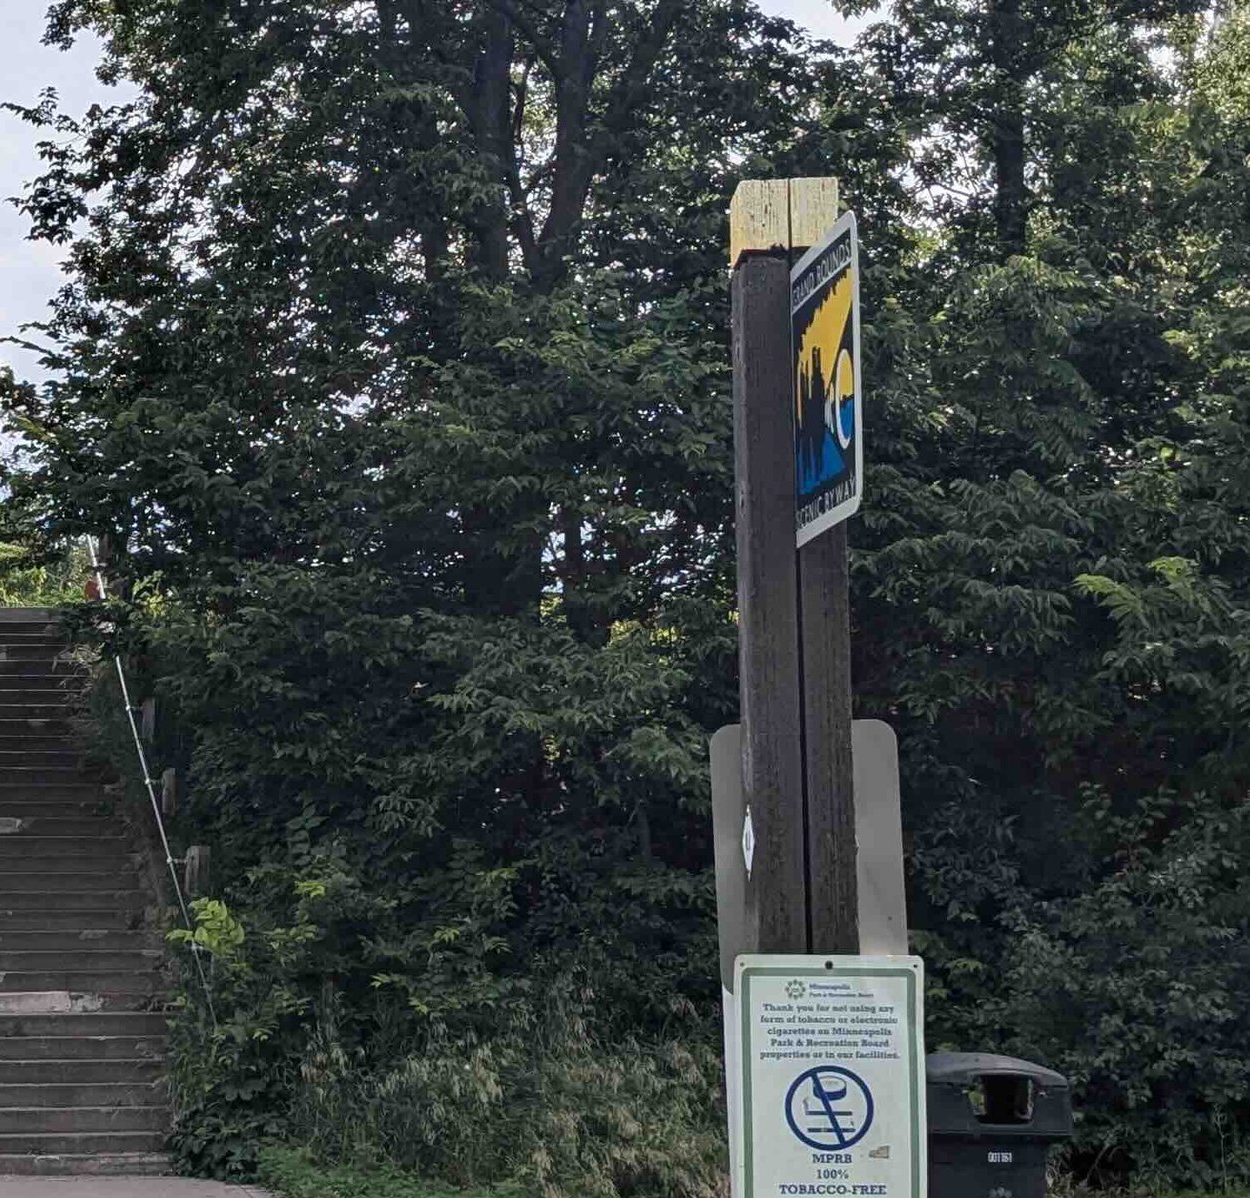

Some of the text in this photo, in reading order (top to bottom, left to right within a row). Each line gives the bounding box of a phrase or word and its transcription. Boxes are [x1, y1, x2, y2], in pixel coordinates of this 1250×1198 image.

[816, 238, 851, 284] ROUNDS
[796, 472, 856, 526] SCENIC BYWAY
[763, 1003, 894, 1014] Thank you for not using any
[760, 1015, 784, 1024] form
[787, 1015, 796, 1024] of
[798, 1015, 836, 1024] tobacco
[850, 1015, 898, 1024] electronic
[767, 1027, 815, 1037] cigarettes
[832, 1027, 892, 1037] Minneapolis
[770, 1039, 889, 1047] Park & Recreation Board
[760, 1051, 810, 1060] properties
[855, 1051, 900, 1059] facilities.
[812, 1153, 852, 1163] MPRB
[816, 1169, 849, 1179] 100%
[779, 1184, 887, 1195] TOBACCO-FREE
